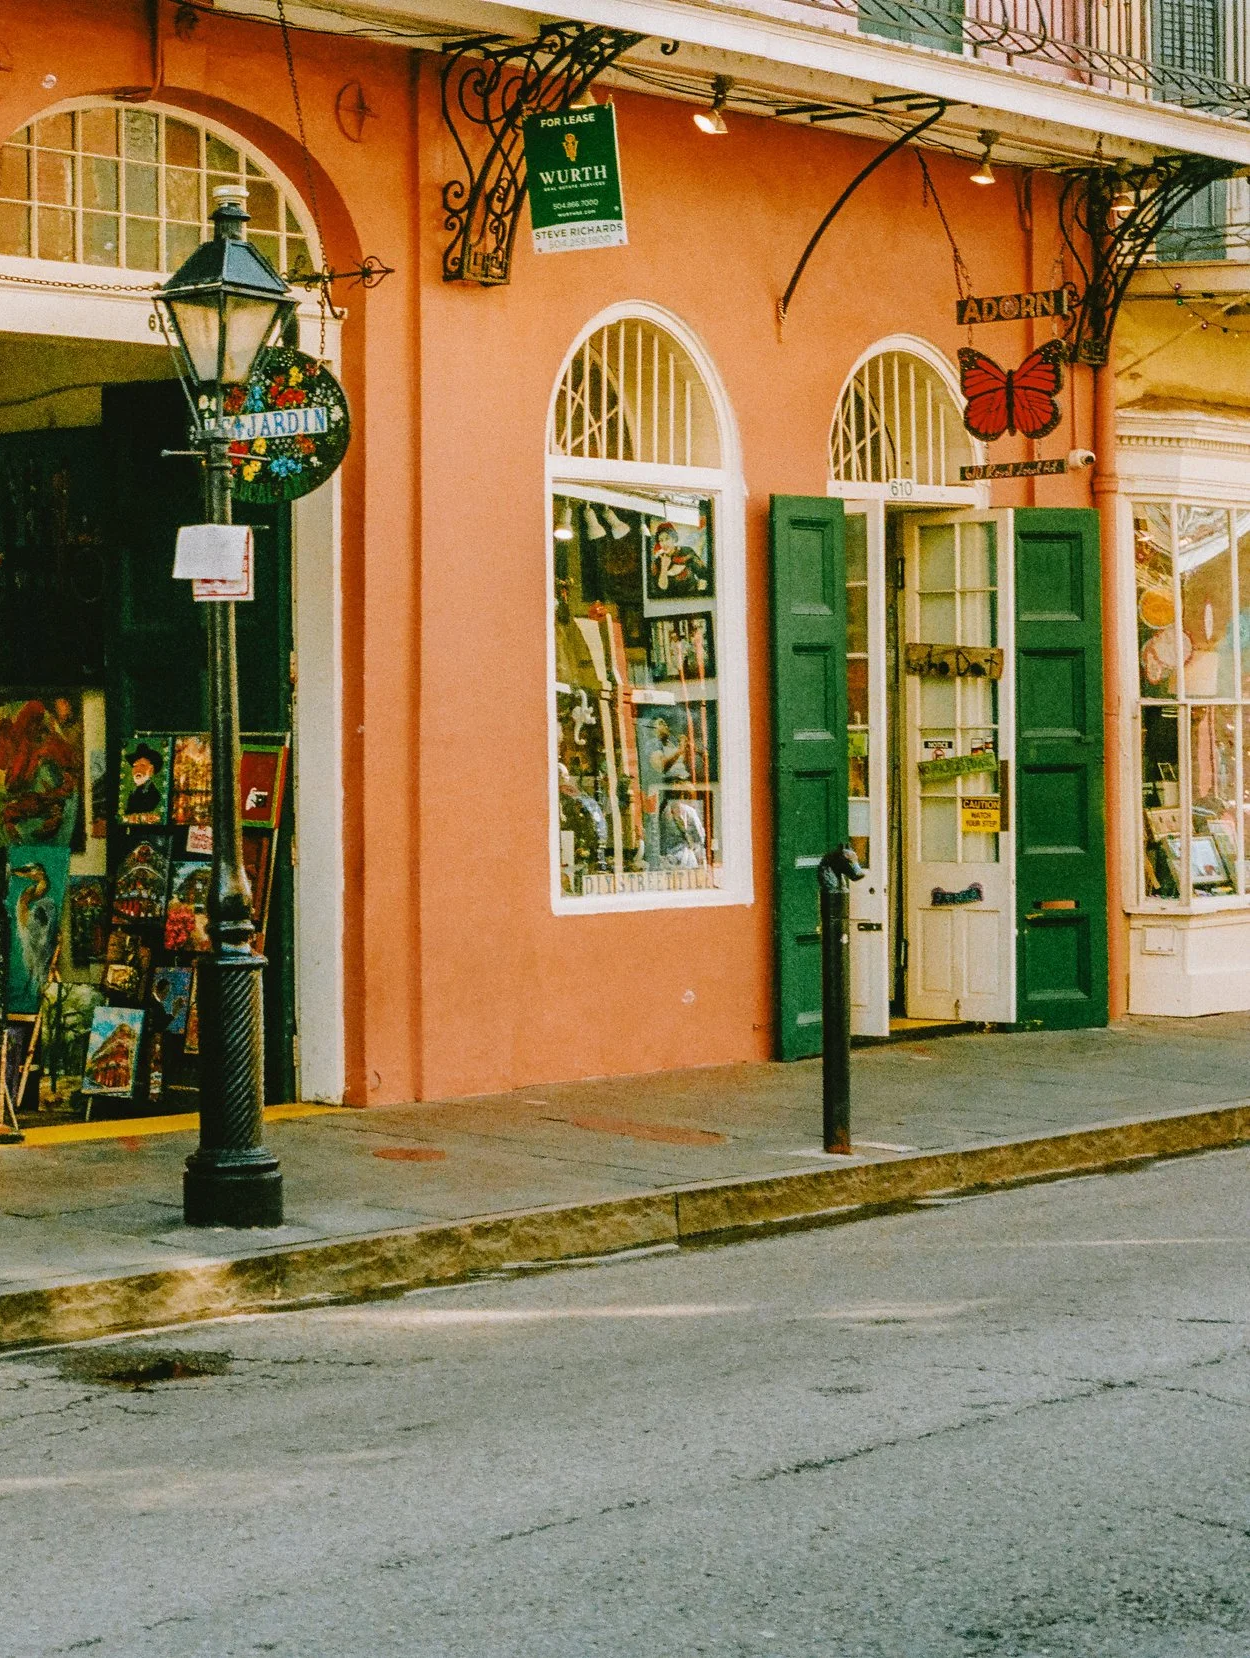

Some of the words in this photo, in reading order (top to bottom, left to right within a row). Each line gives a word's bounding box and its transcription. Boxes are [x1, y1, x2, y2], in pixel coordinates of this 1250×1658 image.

[540, 117, 561, 128] FOR
[563, 113, 596, 125] LEASE
[539, 165, 608, 185] WURTH
[535, 229, 567, 240] STEVE
[570, 223, 623, 236] RICHARDS
[962, 290, 1055, 324] ADORN
[247, 407, 326, 438] JARDIN
[890, 480, 913, 497] 610
[963, 801, 999, 809] CAUTION
[618, 872, 672, 893] STREET
